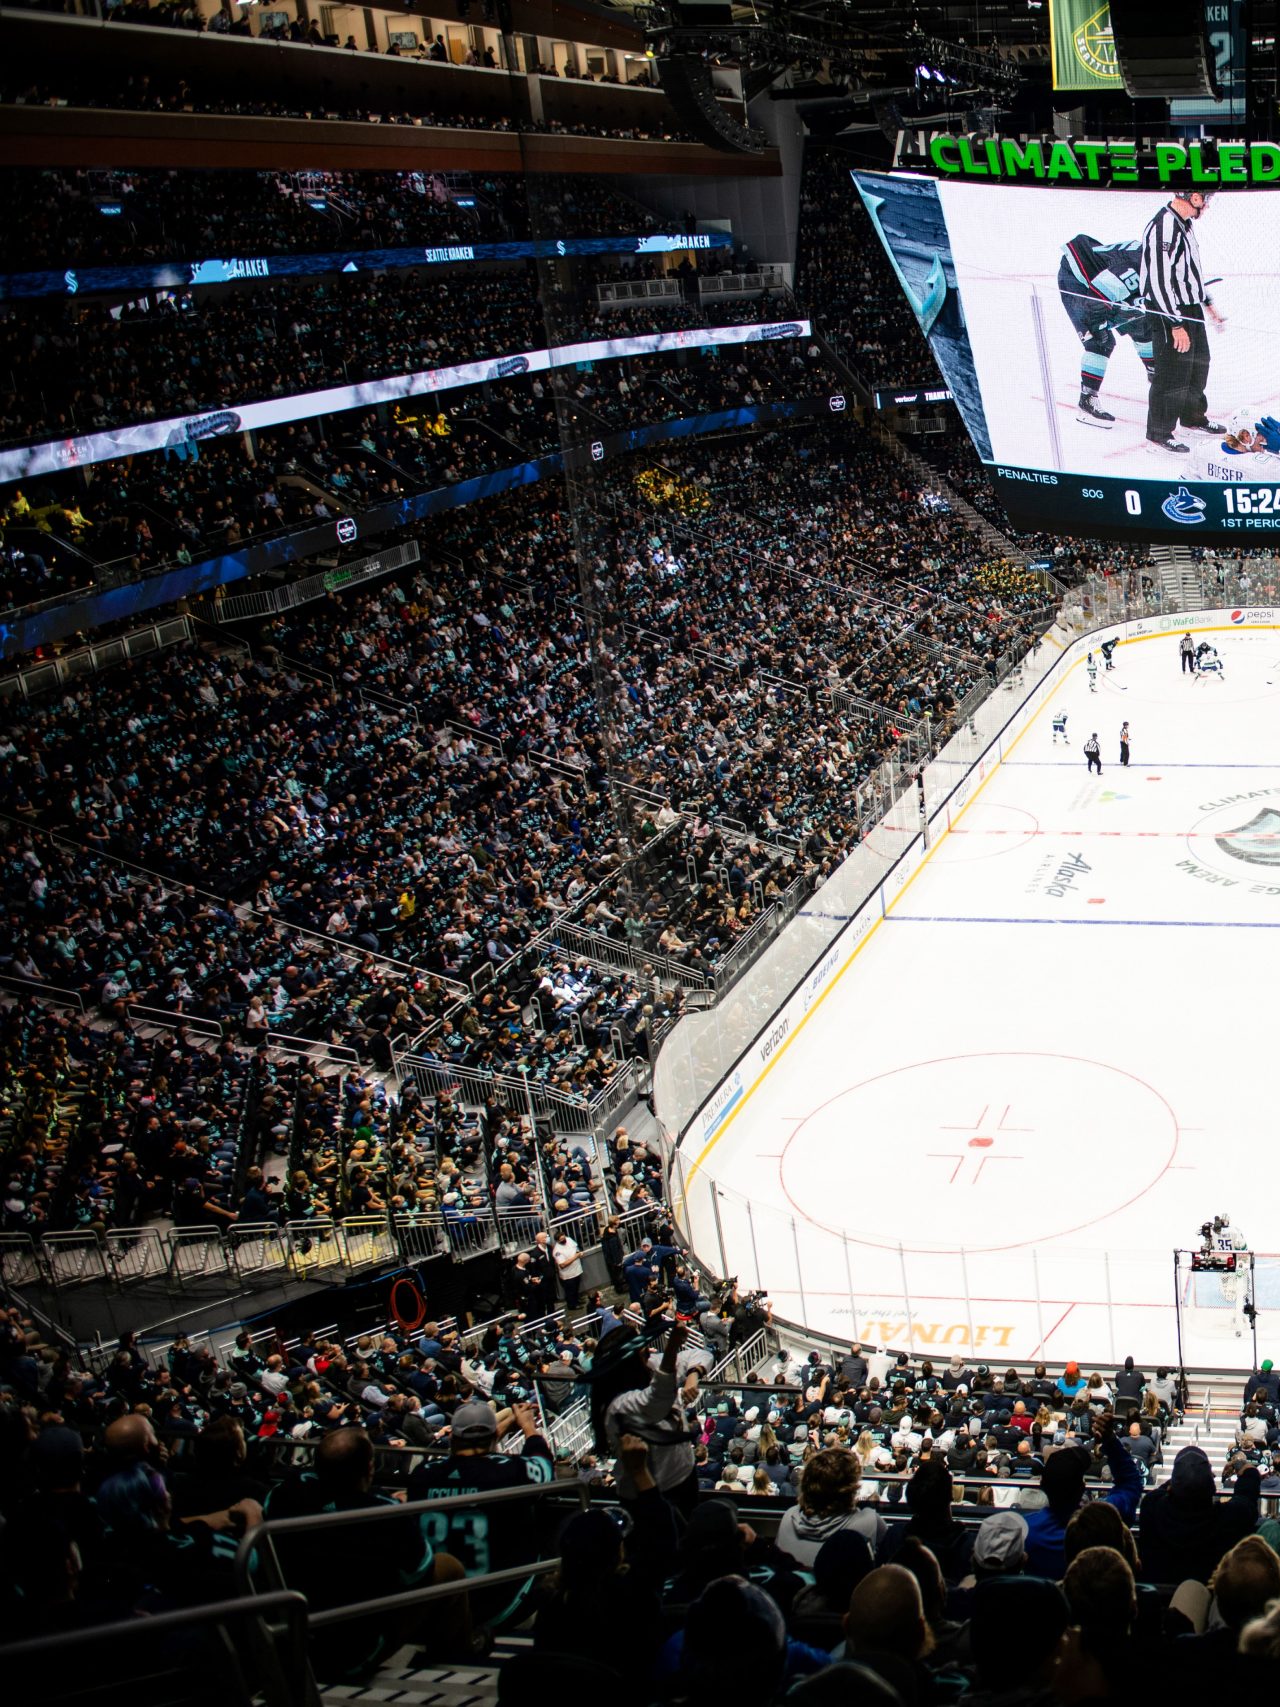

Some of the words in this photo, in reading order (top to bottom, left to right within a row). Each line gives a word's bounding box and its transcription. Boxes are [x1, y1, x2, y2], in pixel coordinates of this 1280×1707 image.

[1204, 6, 1229, 22] KEN
[1077, 36, 1116, 75] SEATTLE
[930, 135, 1138, 181] CLIMATE
[425, 248, 449, 263] SEATTLE
[449, 246, 474, 261] KRAKEN
[924, 391, 946, 402] THANK
[997, 468, 1058, 485] PENALTIES
[1082, 488, 1104, 499] SOG
[1125, 490, 1142, 515] 0
[1221, 518, 1243, 528] 1ST
[1247, 609, 1275, 619] pepsi
[1044, 852, 1092, 898] Alaska
[1174, 857, 1239, 888] ARENA
[812, 949, 840, 989] BOEING
[760, 1017, 789, 1062] verizon
[702, 1084, 733, 1128] PREMERA
[860, 1321, 1016, 1347] LiUNA!
